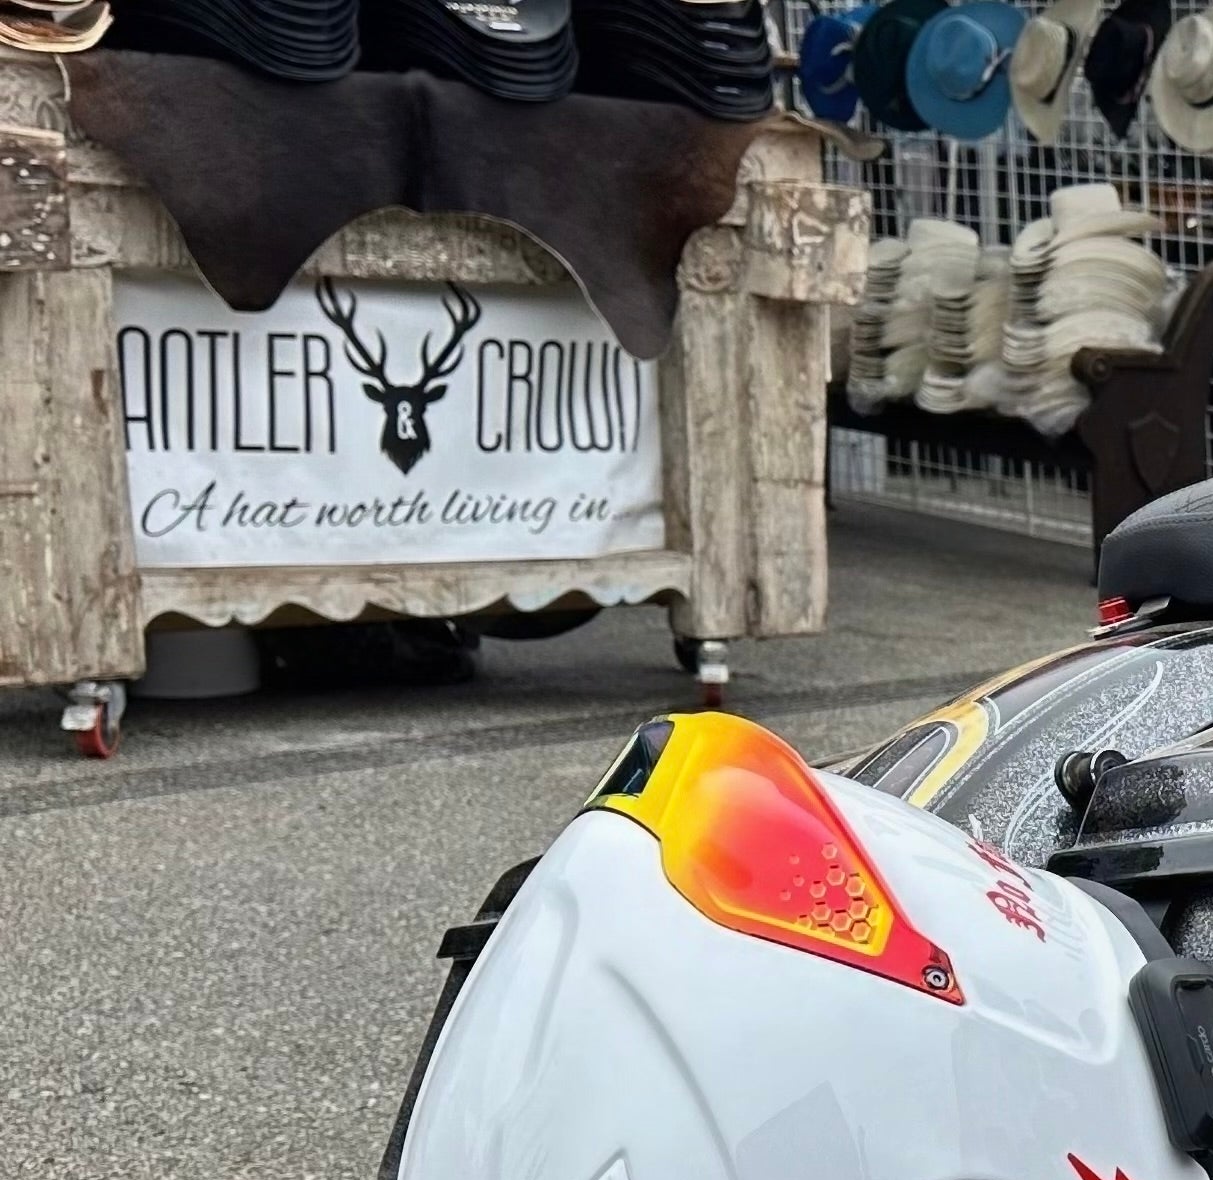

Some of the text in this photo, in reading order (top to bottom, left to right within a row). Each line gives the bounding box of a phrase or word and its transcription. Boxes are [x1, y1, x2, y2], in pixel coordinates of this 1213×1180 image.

[117, 326, 641, 453] ANTLER & CROWN
[141, 480, 216, 537] A
[222, 490, 312, 528] hat
[315, 489, 434, 528] worth
[440, 488, 558, 534] living
